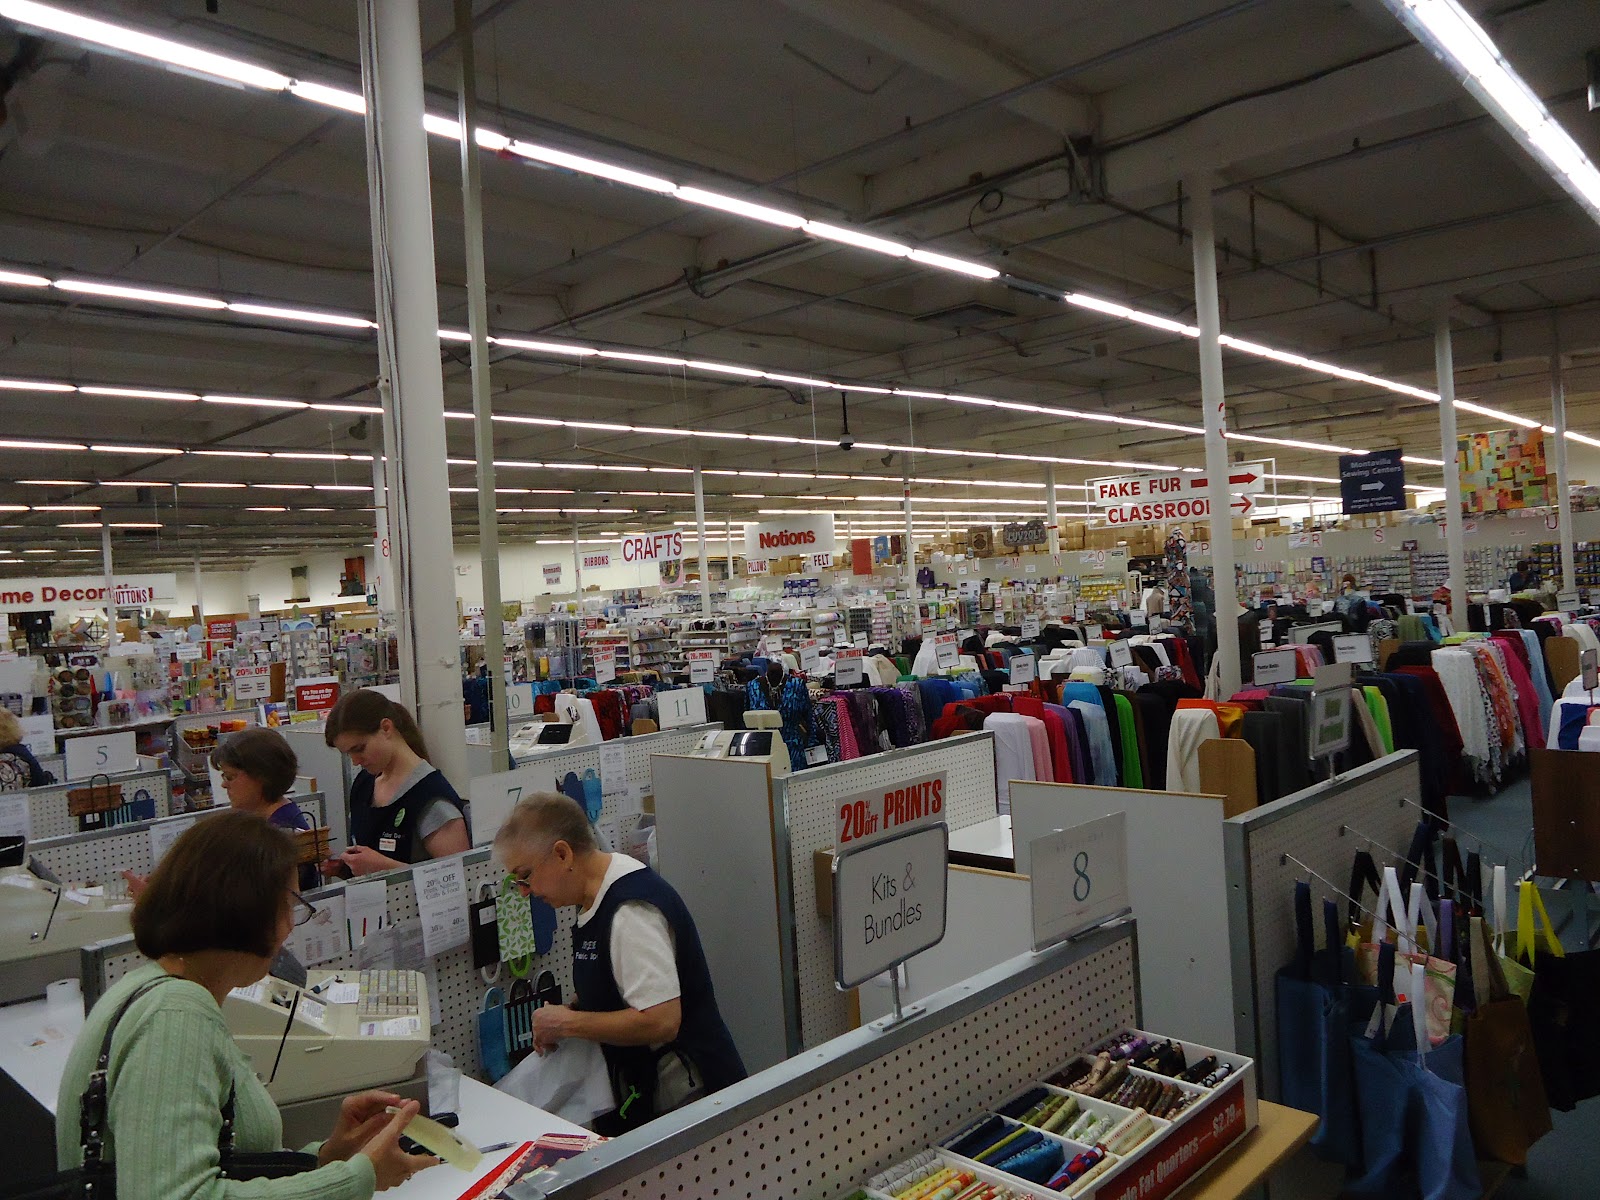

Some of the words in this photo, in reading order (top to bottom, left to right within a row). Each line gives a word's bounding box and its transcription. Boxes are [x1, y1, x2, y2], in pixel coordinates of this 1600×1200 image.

[1100, 481, 1141, 498] FAKE
[1150, 477, 1181, 494] FUR
[1108, 499, 1210, 523] CLASSROO
[1546, 515, 1558, 529] U
[759, 529, 816, 549] Notions
[1255, 538, 1264, 550] Q
[1312, 533, 1320, 547] R
[1375, 529, 1384, 543] S
[623, 532, 682, 562] CRAFTS
[1202, 543, 1209, 555] P
[584, 555, 609, 567] RIBBONS
[748, 560, 767, 573] PILLOWS
[813, 554, 829, 566] FELT
[236, 668, 253, 676] 20%
[254, 666, 268, 675] OFF
[675, 698, 689, 718] 11
[96, 745, 108, 766] 5
[883, 778, 942, 830] PRINTS
[442, 873, 455, 882] OFF
[872, 872, 897, 904] Kits
[902, 862, 916, 892] &
[1073, 851, 1091, 902] 8
[864, 898, 922, 945] Bundles
[1156, 1136, 1199, 1184] Quarters
